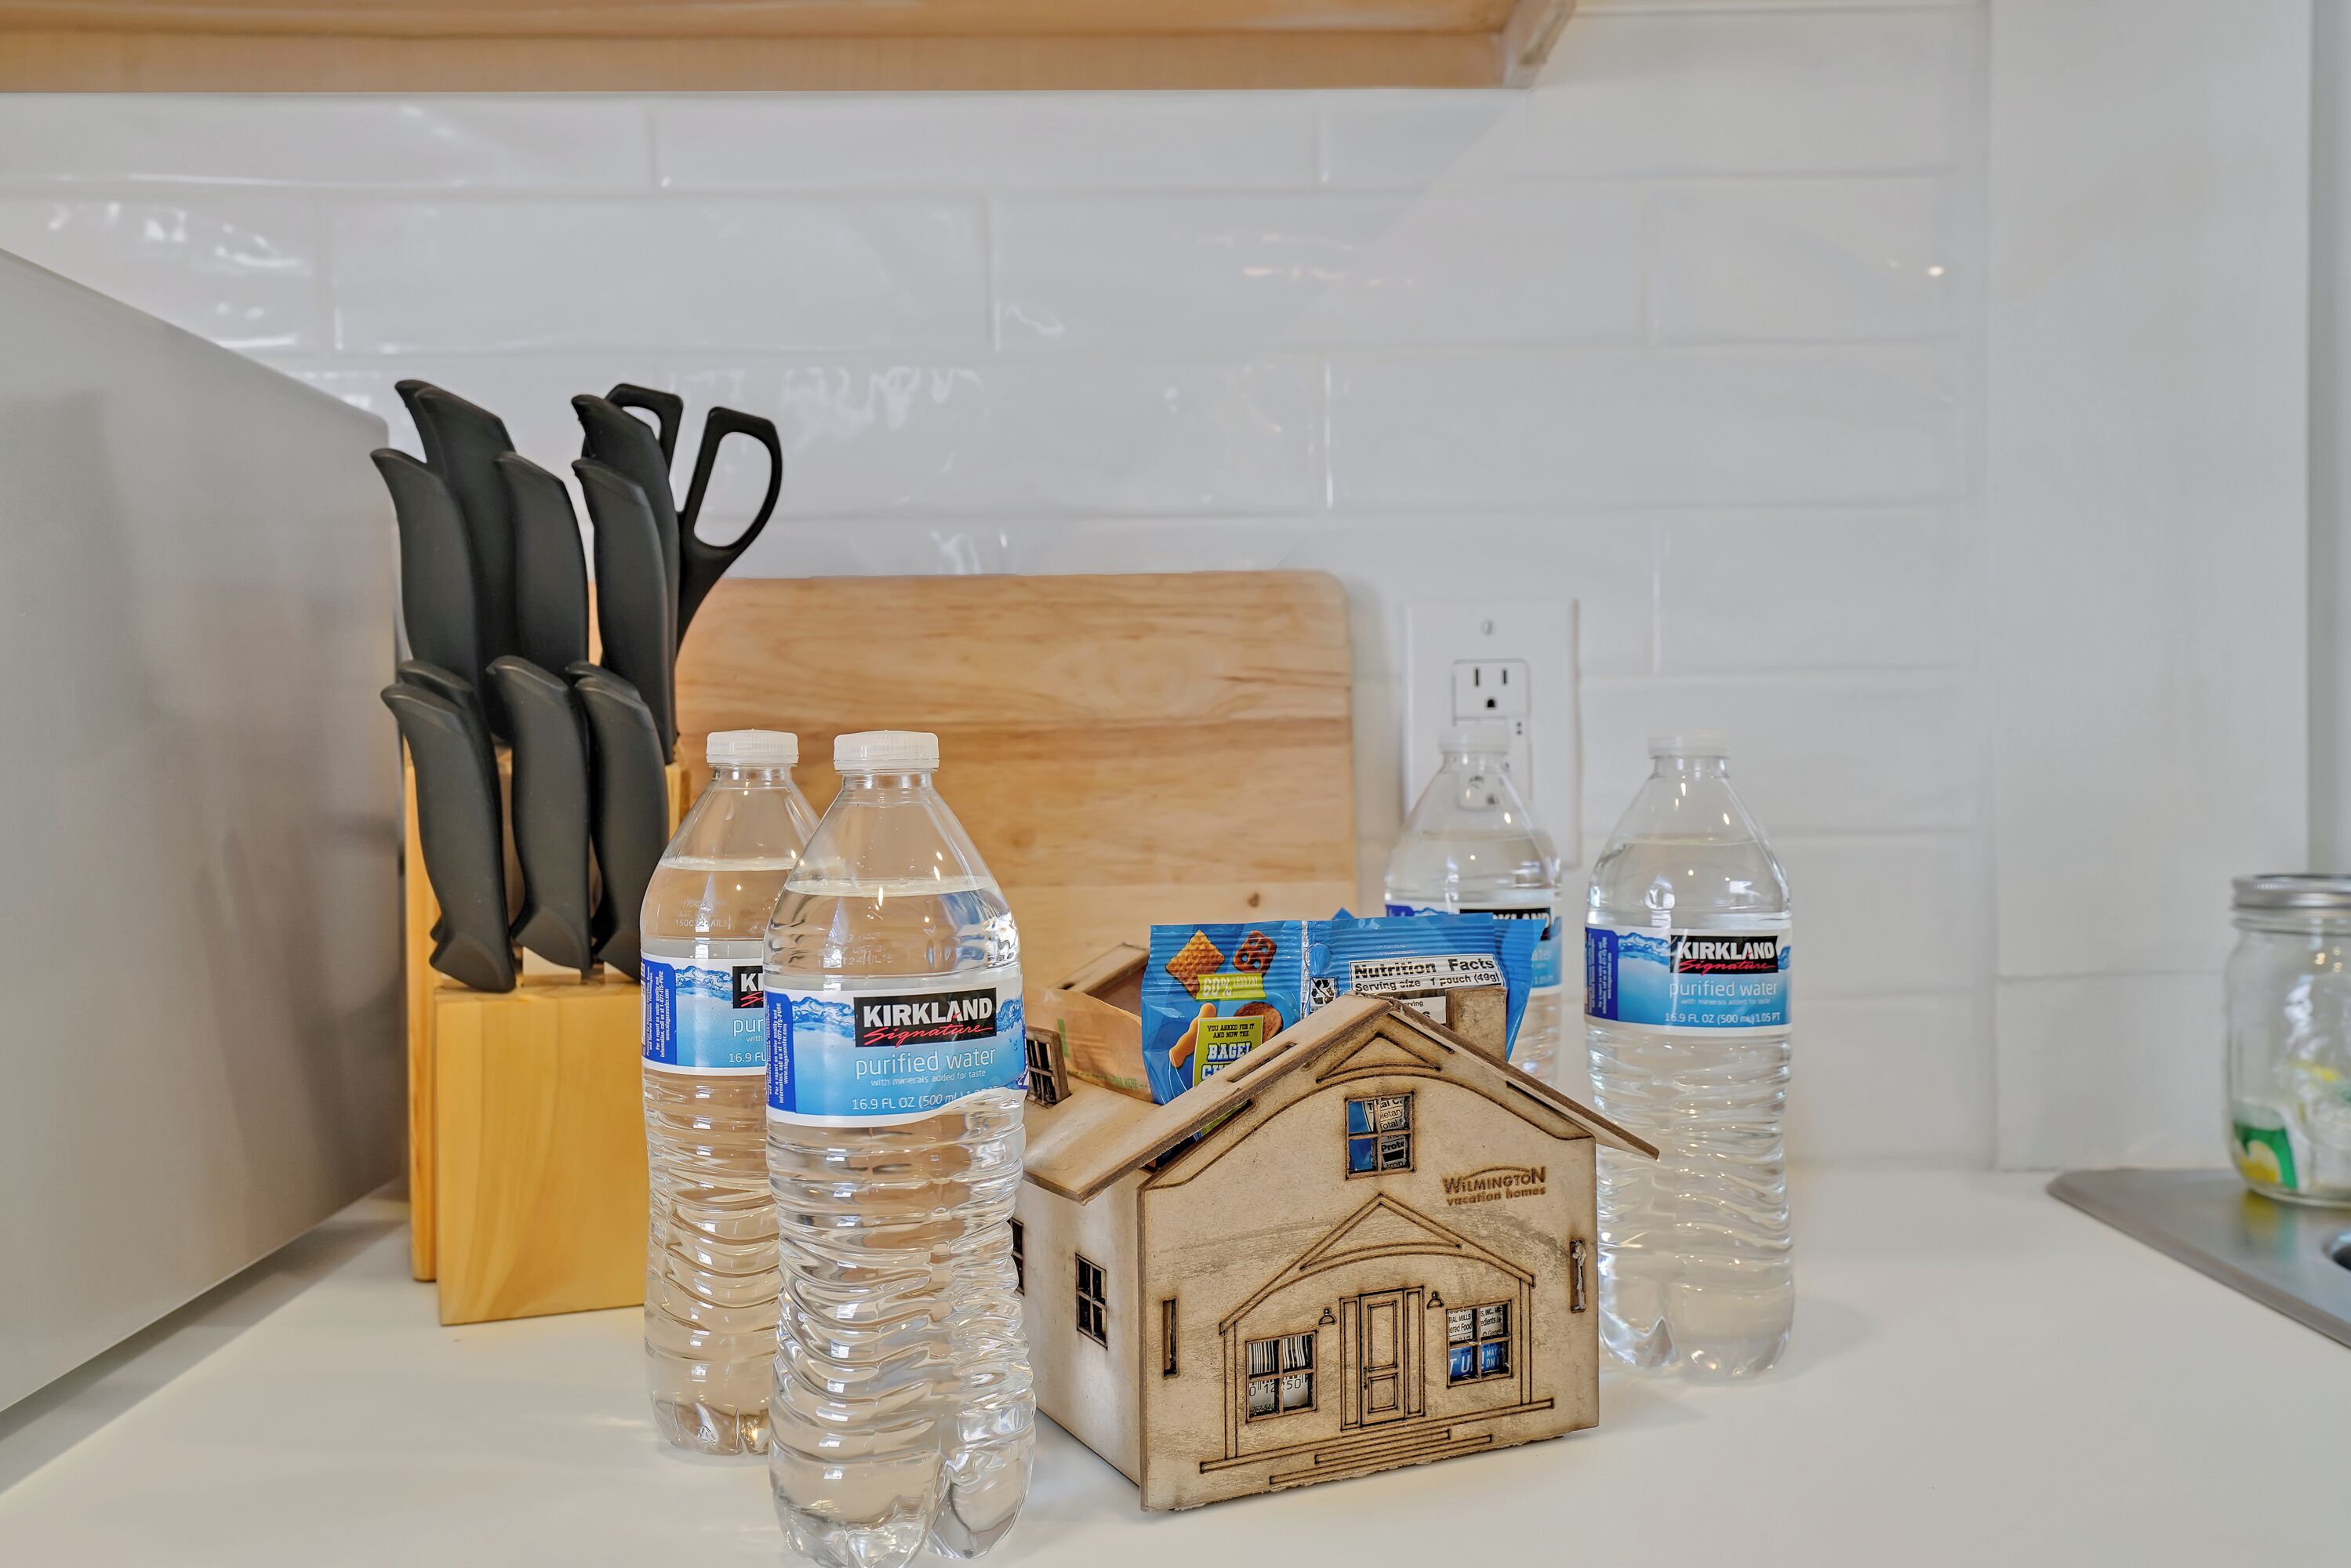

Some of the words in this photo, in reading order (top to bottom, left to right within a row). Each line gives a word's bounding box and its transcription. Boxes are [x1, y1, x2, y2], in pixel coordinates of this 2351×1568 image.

[1677, 941, 1775, 960] KIRKLAND
[1354, 961, 1437, 978] Nutrition
[1448, 958, 1495, 971] Facts
[1678, 959, 1776, 976] Signature
[1203, 977, 1232, 997] 60%
[1355, 981, 1397, 993] Serving
[1400, 979, 1421, 989] size
[1430, 977, 1435, 985] 1
[1440, 975, 1471, 987] pouch
[1473, 972, 1500, 984] (49g)
[1669, 980, 1735, 998] purified
[1740, 982, 1778, 996] water
[863, 997, 994, 1028] KIRKLAND
[1664, 1012, 1685, 1023] 16.9
[1688, 1012, 1700, 1023] FL
[1702, 1014, 1714, 1024] OZ
[1717, 1014, 1738, 1025] (500
[1756, 1013, 1771, 1023] 1.05
[1772, 1012, 1781, 1022] PT
[863, 1023, 994, 1048] Signature
[729, 1052, 752, 1062] 16.9
[754, 1051, 765, 1062] FL
[1207, 1040, 1252, 1062] BAGEL
[856, 1051, 939, 1080] purified
[947, 1048, 997, 1070] water
[932, 1073, 955, 1083] added
[957, 1071, 967, 1080] for
[968, 1069, 986, 1079] taste
[852, 1098, 878, 1110] 16.9
[881, 1098, 896, 1109] FL
[899, 1097, 915, 1109] OZ
[918, 1094, 942, 1109] (500
[1382, 1142, 1404, 1152] Prote
[1447, 1191, 1502, 1206] vacation
[1506, 1187, 1546, 1200] homes
[1459, 1313, 1471, 1322] MILLS
[1481, 1317, 1496, 1327] edients
[1249, 1386, 1256, 1396] 0
